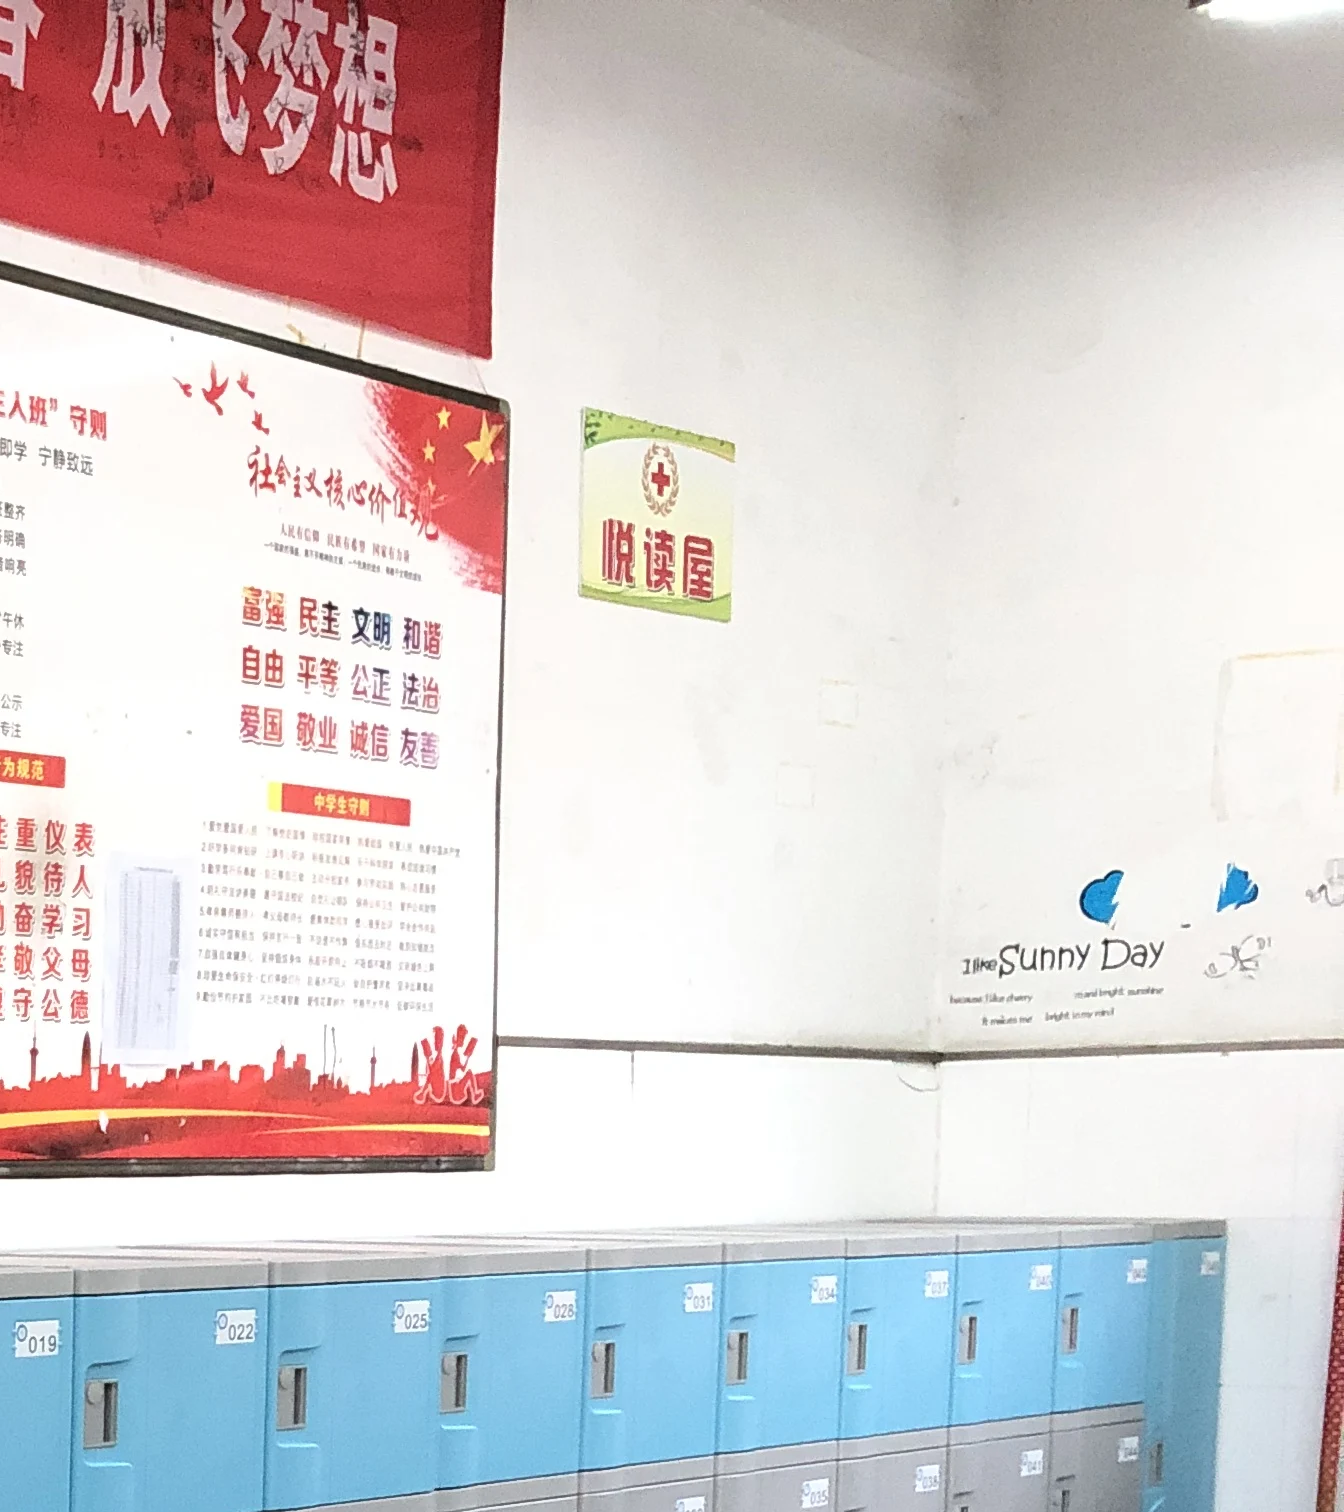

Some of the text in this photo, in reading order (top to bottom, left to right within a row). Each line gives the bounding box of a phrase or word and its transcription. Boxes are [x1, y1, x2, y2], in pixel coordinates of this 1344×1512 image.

[69, 405, 108, 440] 守则
[38, 446, 94, 477] 宁静致远
[602, 518, 715, 602] 悦读屋
[241, 586, 443, 659] 富强 民主 文明 和谐
[241, 645, 441, 713] 自由 平等 公正 法治
[240, 704, 441, 770] 爱国 敬业 诚信 友善
[313, 790, 370, 817] 中学生守则
[973, 957, 997, 973] like
[998, 942, 1091, 979] Sunny
[1101, 938, 1165, 972] Day
[817, 1286, 837, 1301] 034
[227, 1322, 255, 1342] 022
[403, 1313, 429, 1330] 025
[28, 1334, 58, 1354] 019
[810, 1489, 828, 1505] 035
